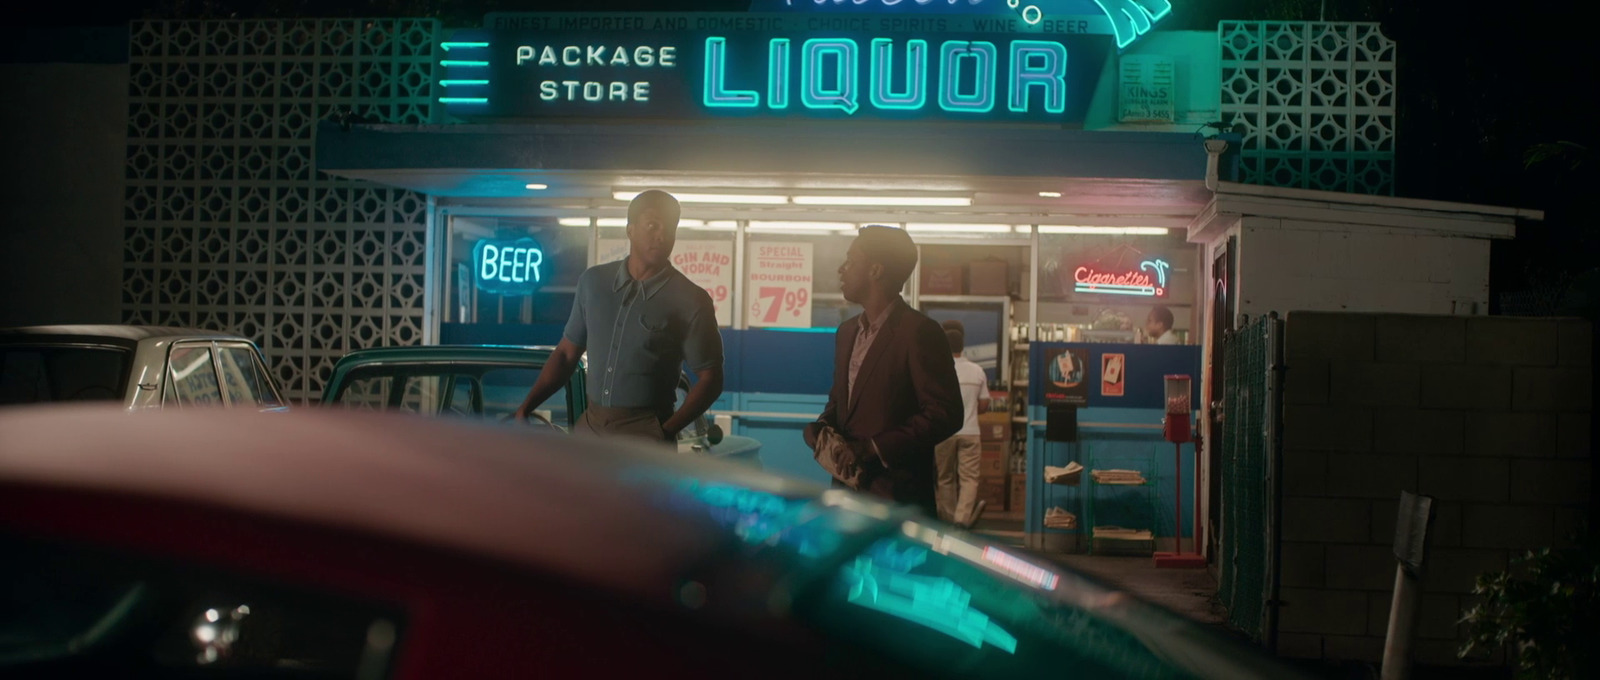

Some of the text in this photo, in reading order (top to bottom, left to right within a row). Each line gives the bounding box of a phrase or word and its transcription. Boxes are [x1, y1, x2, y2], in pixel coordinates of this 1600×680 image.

[495, 16, 1089, 33] FINEST IMPORTED AND DOMESTIC CHOICE SPIRITS WINE BEER
[516, 45, 678, 67] PACKAGE
[703, 36, 1068, 115] LIQUOR
[539, 80, 651, 101] STORE
[1128, 86, 1168, 98] KINGS
[673, 251, 730, 266] GIN AND
[759, 246, 804, 257] SPECIAL
[481, 244, 543, 283] BEER
[681, 263, 720, 276] VODKA
[759, 261, 803, 270] Straight
[751, 273, 811, 282] BOURBON
[1074, 266, 1154, 290] Cigarettes
